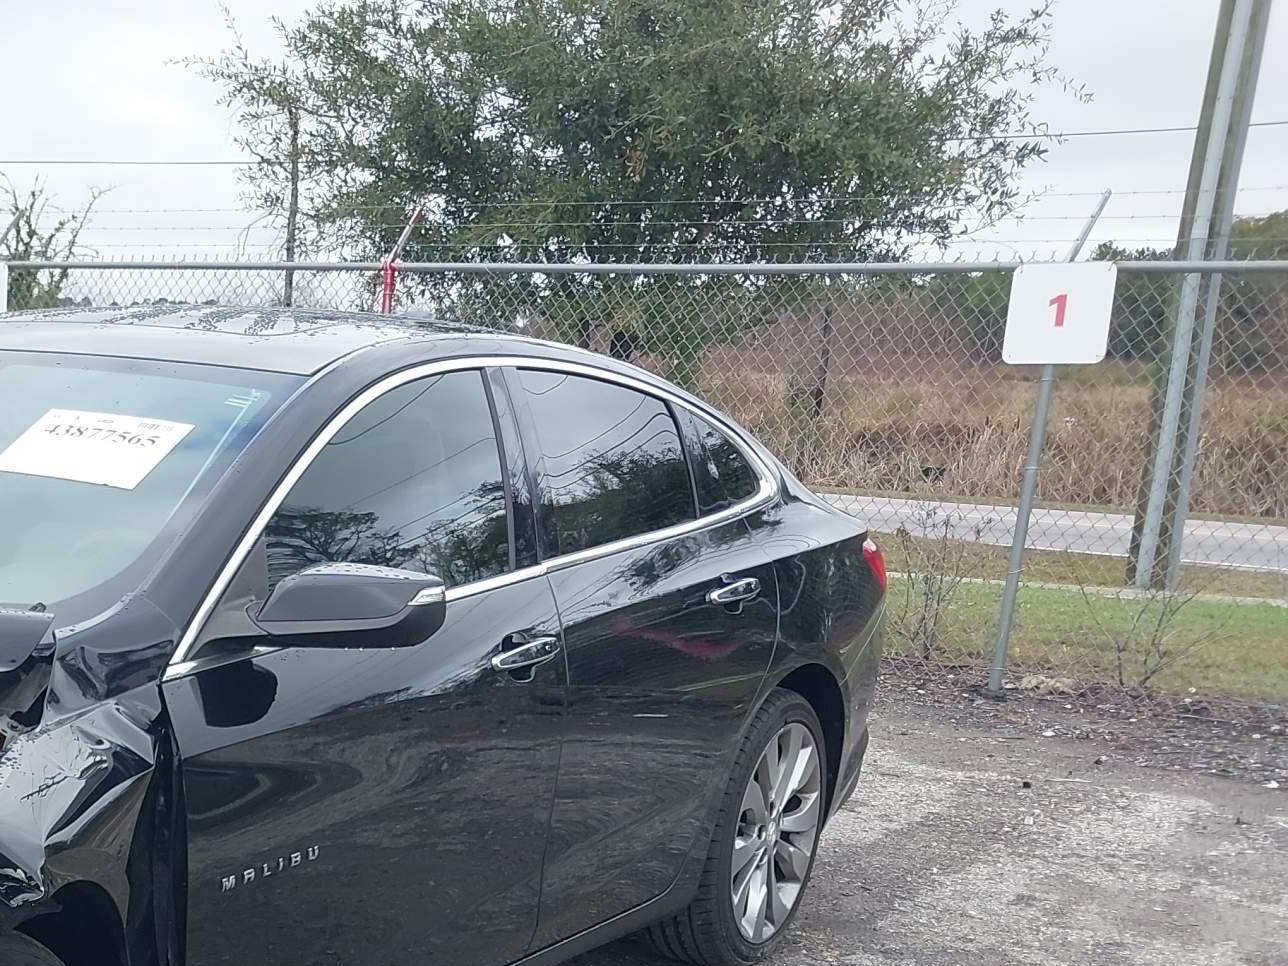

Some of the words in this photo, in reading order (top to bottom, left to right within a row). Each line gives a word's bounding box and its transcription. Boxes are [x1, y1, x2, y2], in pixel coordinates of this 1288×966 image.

[1048, 293, 1068, 327] 1
[44, 423, 161, 447] 43877565
[221, 845, 319, 892] MALIBU
